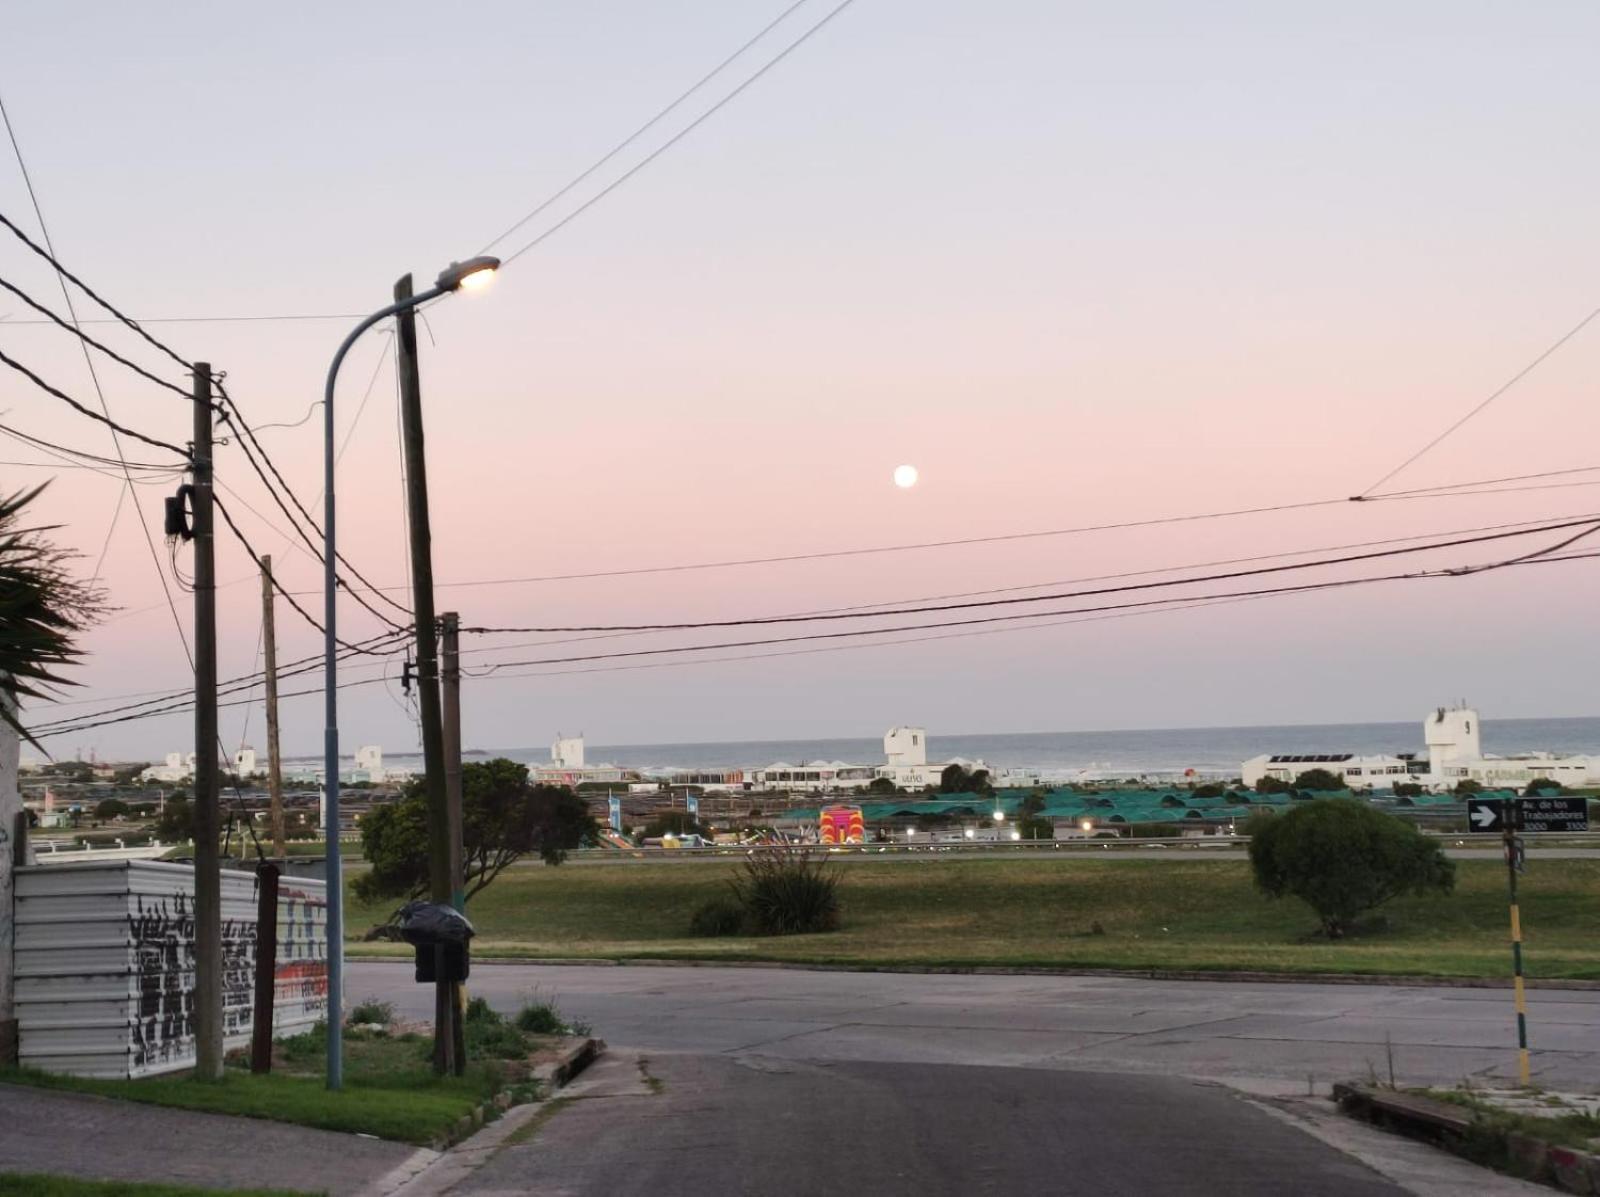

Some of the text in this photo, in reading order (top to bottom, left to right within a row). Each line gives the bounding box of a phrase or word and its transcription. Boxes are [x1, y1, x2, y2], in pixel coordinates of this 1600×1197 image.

[1539, 799, 1552, 809] de
[1553, 799, 1568, 809] los
[1523, 811, 1584, 821] Trabajadores
